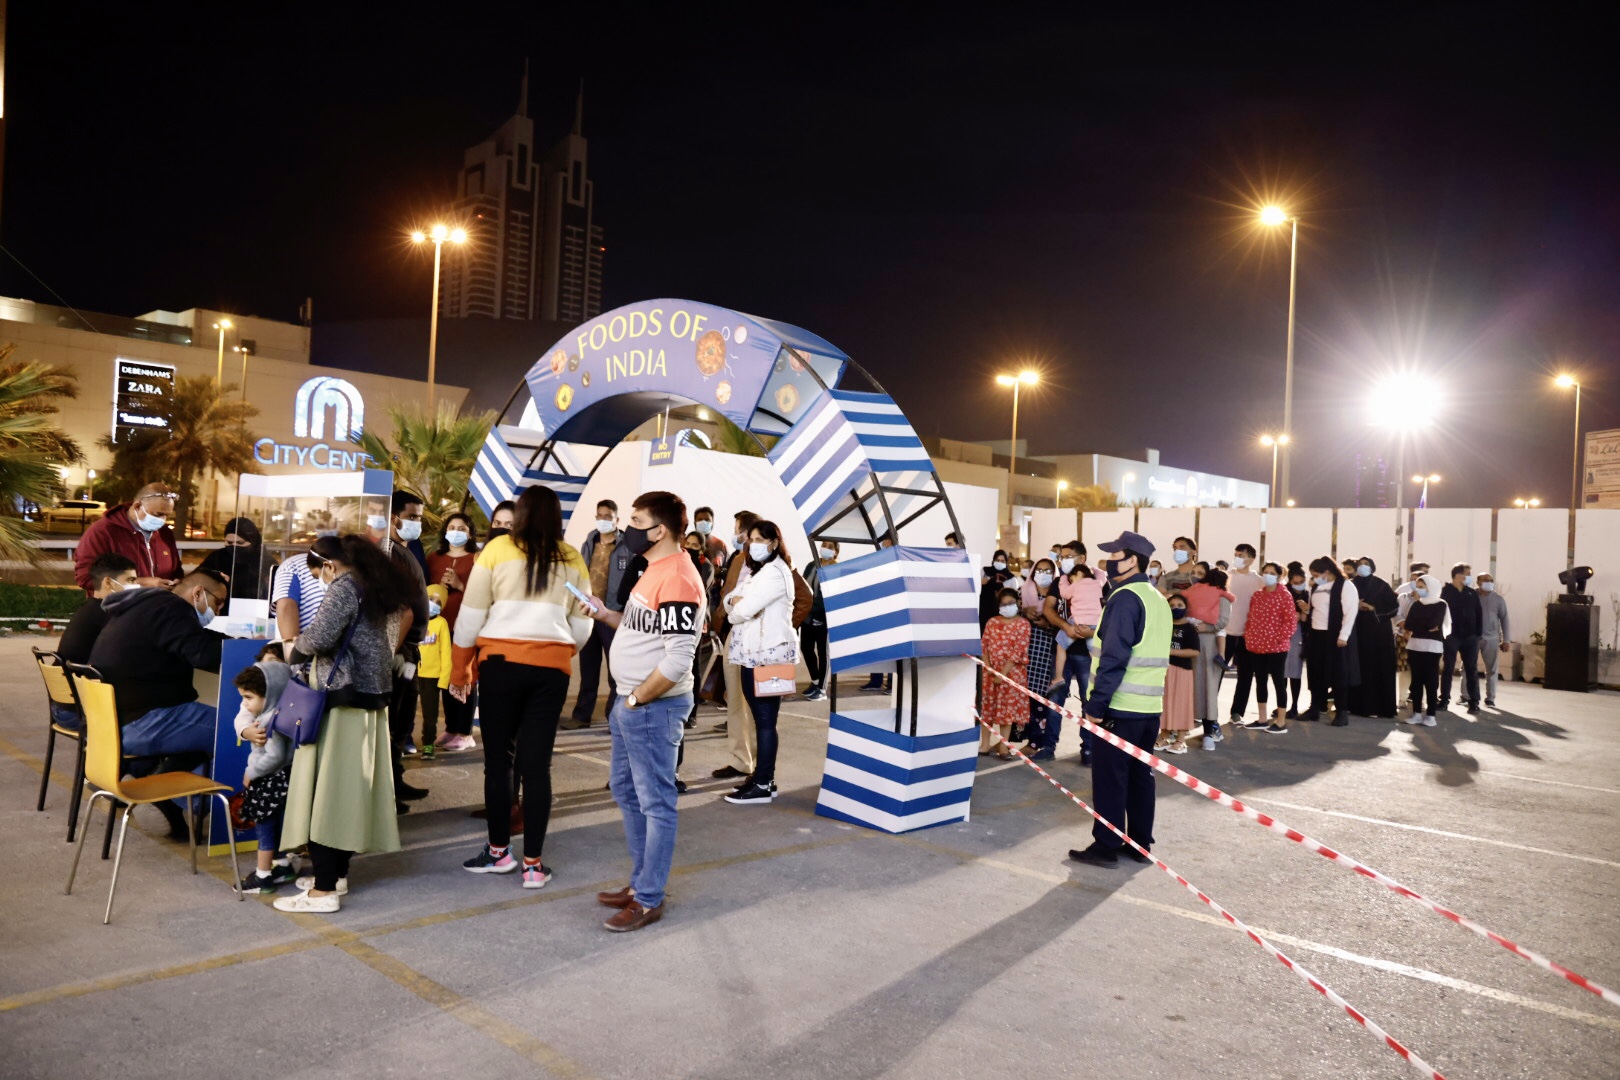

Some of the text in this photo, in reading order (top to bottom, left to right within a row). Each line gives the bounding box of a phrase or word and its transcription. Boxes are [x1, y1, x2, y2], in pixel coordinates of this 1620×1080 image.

[577, 308, 708, 359] FOODS OF
[606, 348, 667, 382] INDIA
[121, 366, 171, 379] DEBENHAMS
[128, 381, 163, 395] ZARA
[658, 443, 668, 451] NO
[652, 451, 672, 460] ENTRY
